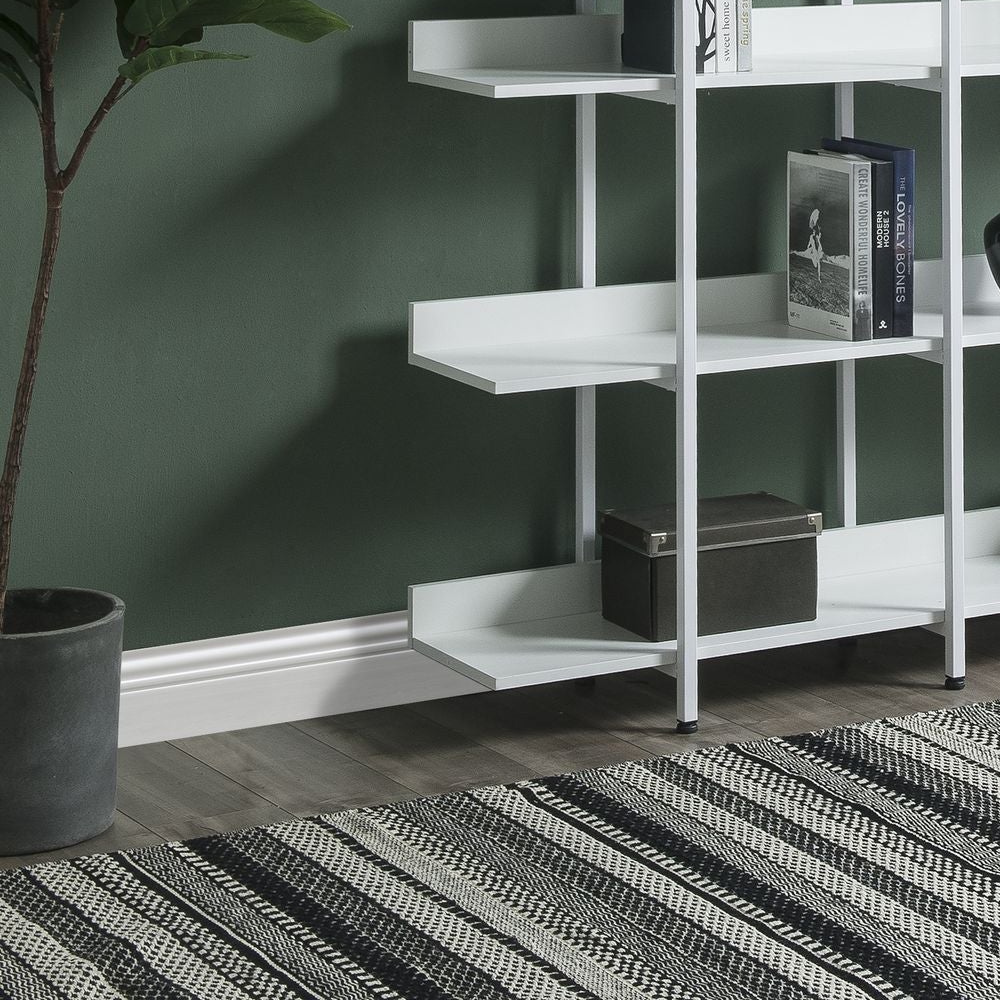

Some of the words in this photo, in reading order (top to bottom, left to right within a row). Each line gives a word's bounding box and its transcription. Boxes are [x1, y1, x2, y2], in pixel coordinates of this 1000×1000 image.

[721, 2, 730, 29] home
[741, 11, 750, 46] spring
[722, 32, 730, 62] sweet
[858, 168, 868, 198] CREATE
[858, 199, 868, 252] WONDERFUL
[896, 193, 906, 249] LOVELY
[858, 254, 868, 295] HOMELIFE
[896, 253, 906, 303] BONES
